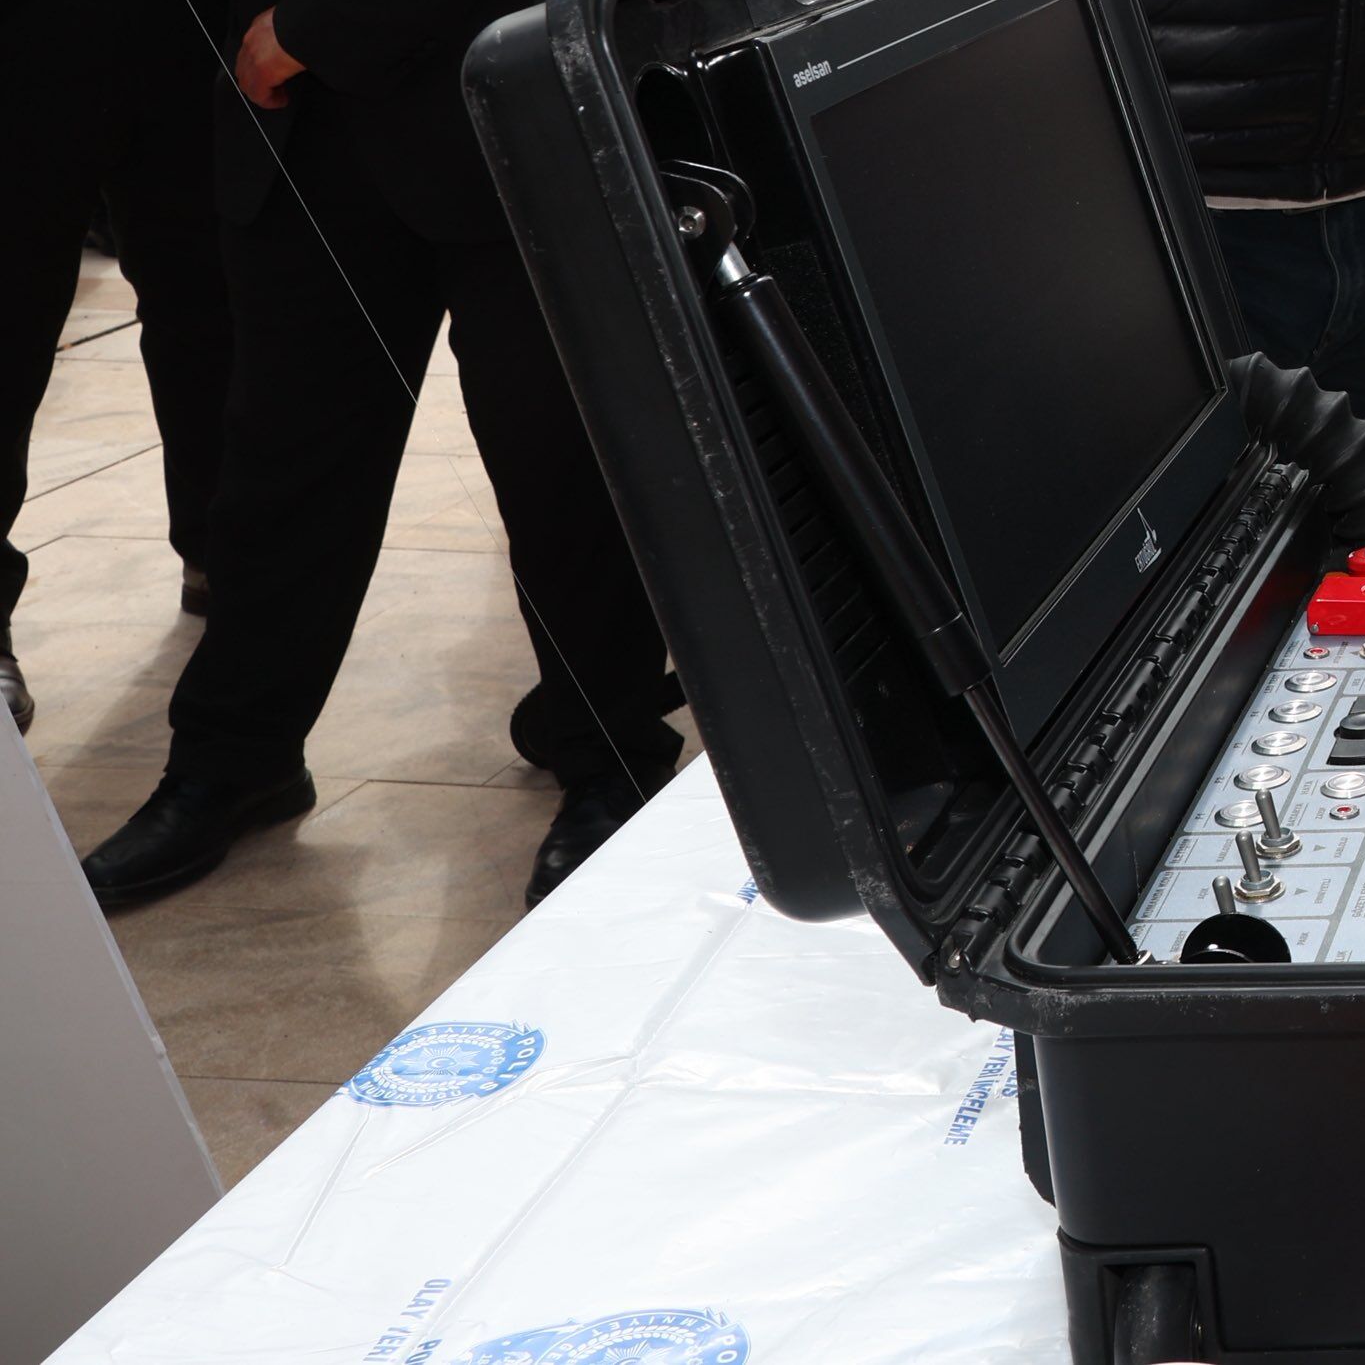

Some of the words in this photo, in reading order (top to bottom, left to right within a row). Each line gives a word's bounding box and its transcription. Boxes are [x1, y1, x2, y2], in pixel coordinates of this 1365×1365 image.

[792, 58, 832, 88] aselsan
[944, 1079, 1000, 1146] İNCELEME
[400, 1278, 453, 1320] OLAY
